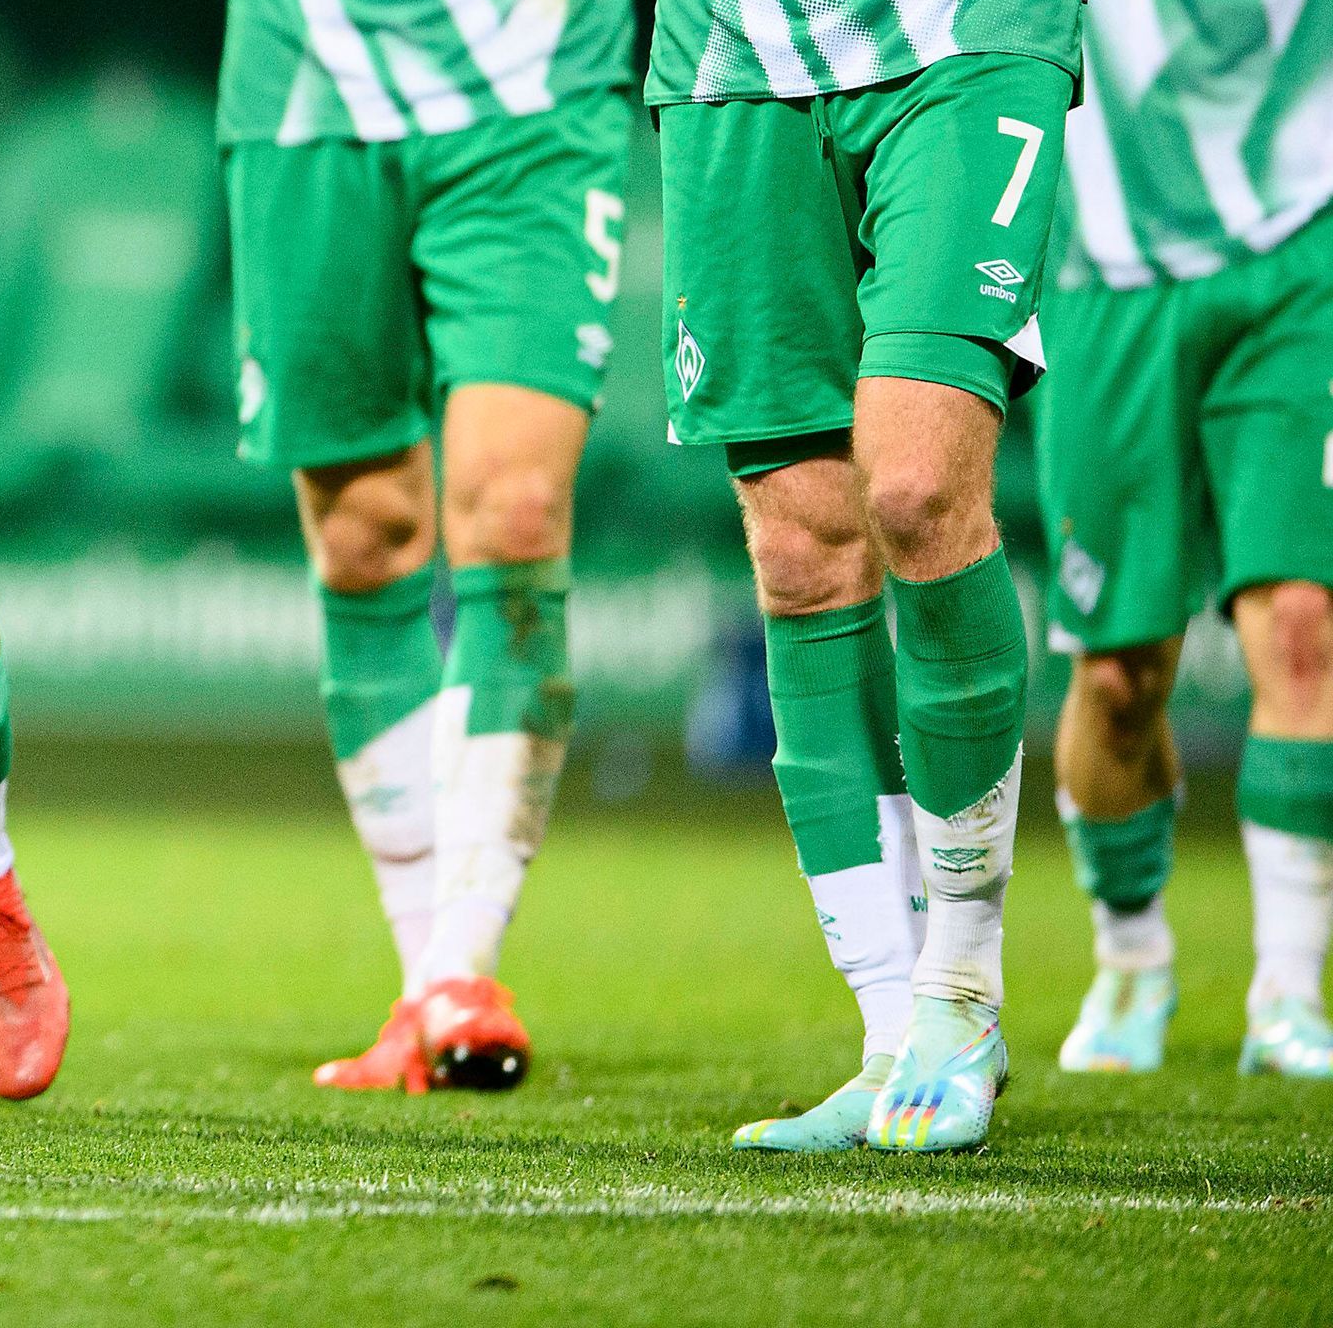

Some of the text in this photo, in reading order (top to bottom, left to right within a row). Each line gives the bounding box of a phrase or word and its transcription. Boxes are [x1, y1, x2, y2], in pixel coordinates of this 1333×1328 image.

[990, 115, 1045, 228] 7
[584, 188, 624, 302] 5
[979, 283, 1017, 304] umbro
